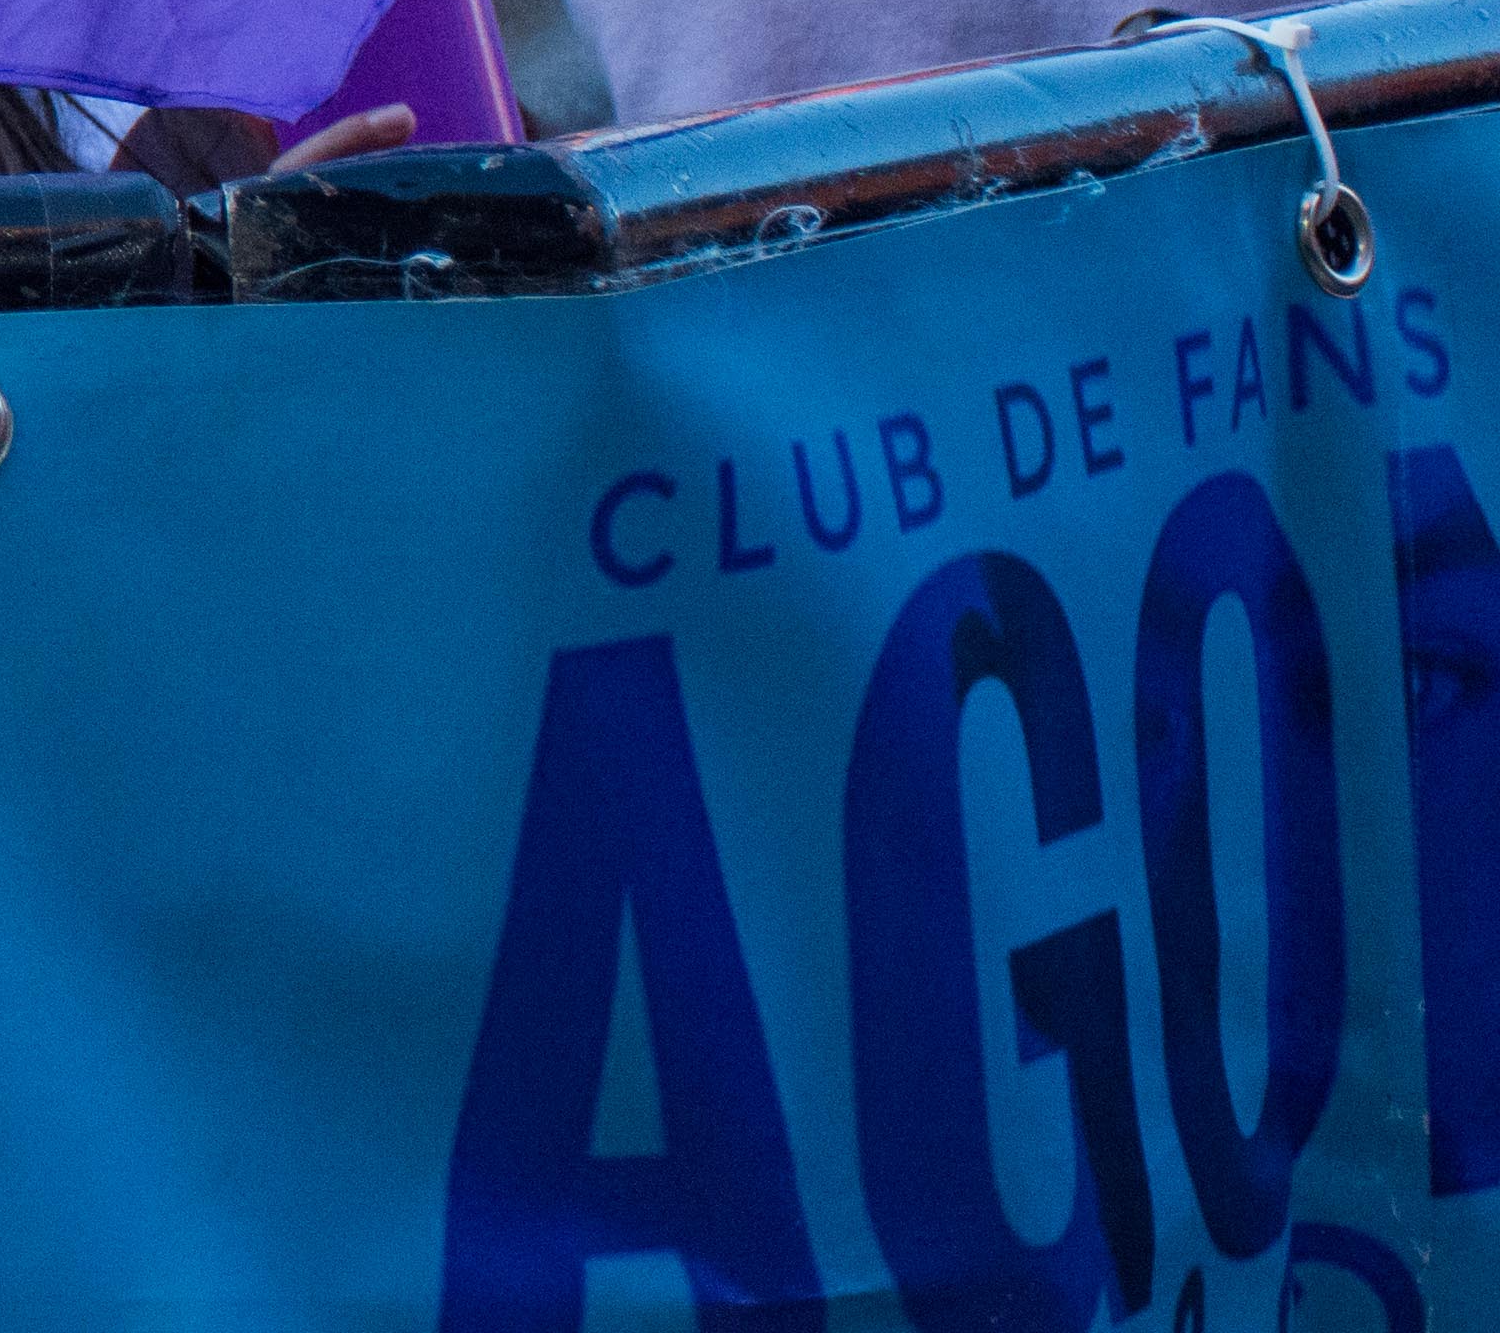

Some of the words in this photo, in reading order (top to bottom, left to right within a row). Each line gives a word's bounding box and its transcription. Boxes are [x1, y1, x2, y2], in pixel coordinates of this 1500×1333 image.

[589, 411, 945, 590] CLUB
[994, 357, 1125, 500] DE
[1173, 288, 1451, 448] FANS
